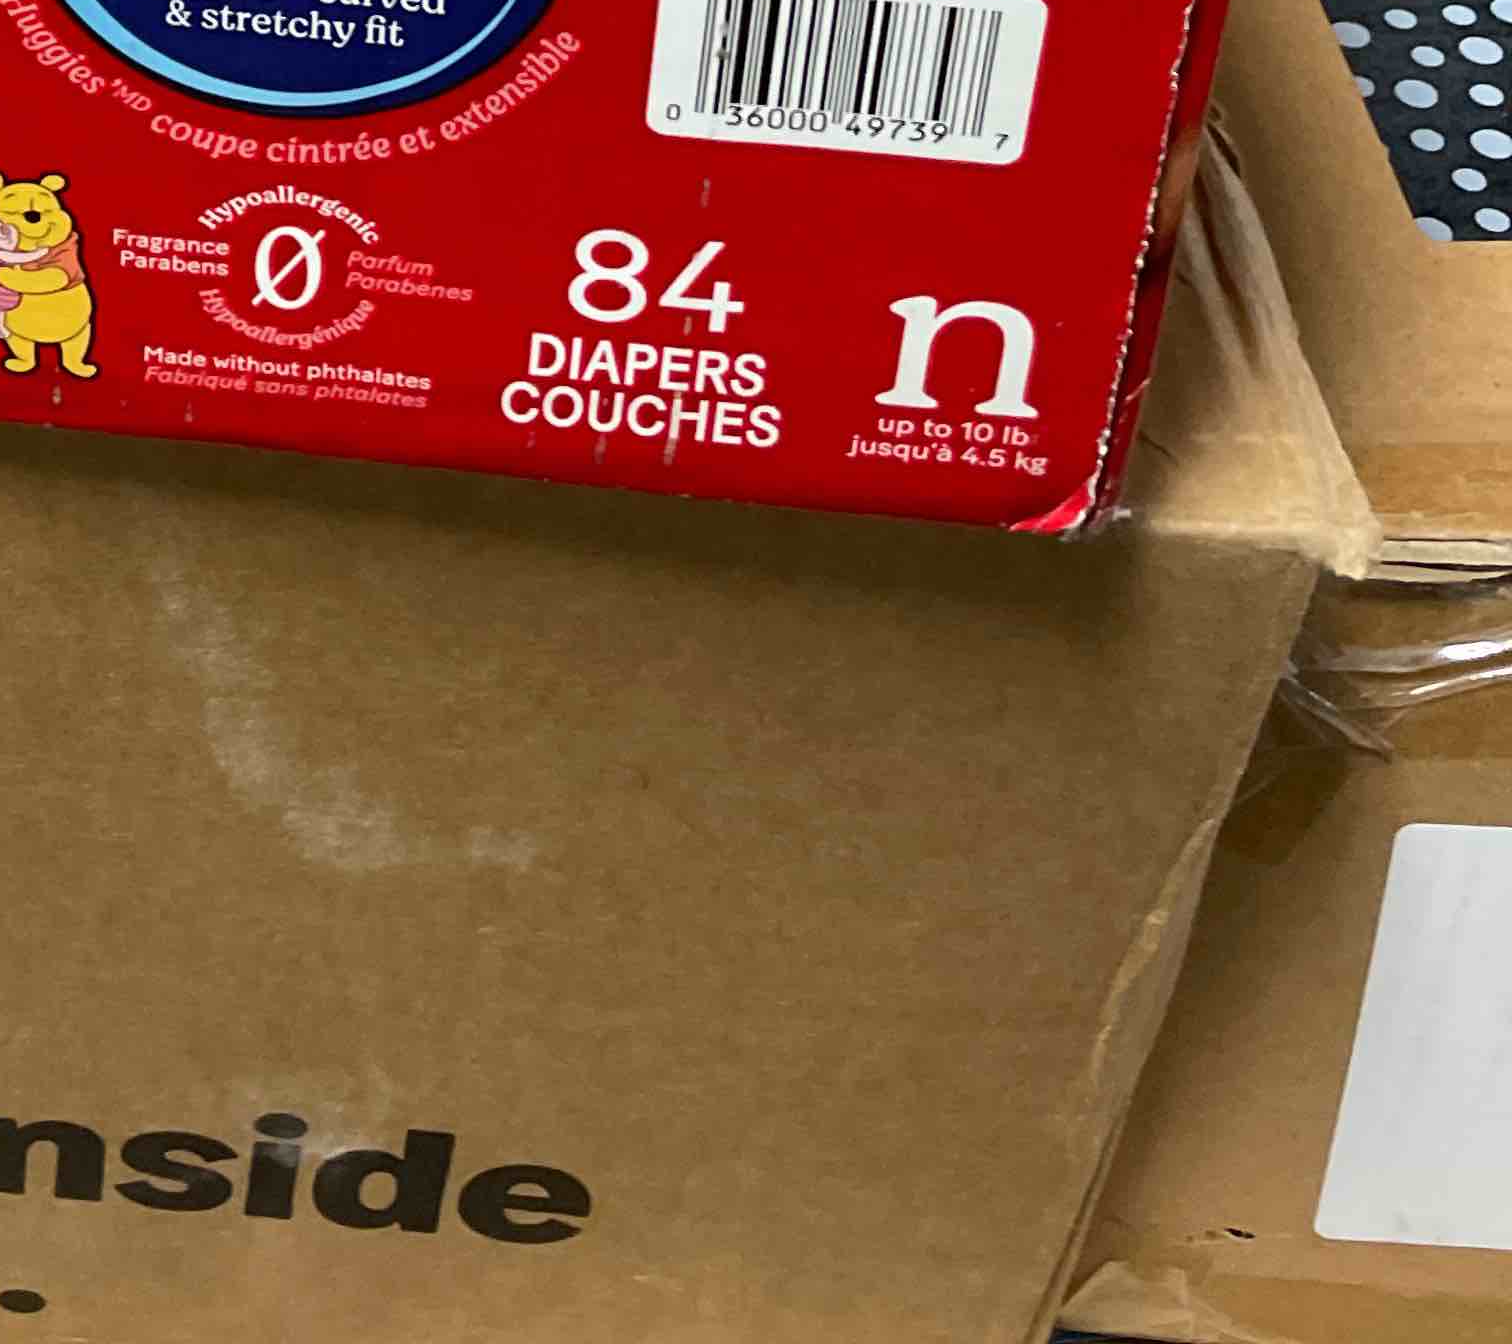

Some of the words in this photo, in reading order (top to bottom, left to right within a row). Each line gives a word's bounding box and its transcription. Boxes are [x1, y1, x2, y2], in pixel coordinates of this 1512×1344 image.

[199, 3, 356, 48] stretchy
[363, 14, 406, 47] fit
[149, 112, 260, 160] coupe
[265, 131, 391, 165] cintrée
[398, 125, 437, 155] et
[439, 30, 582, 143] extensible
[665, 103, 681, 121] 0
[724, 104, 829, 134] 36000
[845, 115, 950, 145] 49739
[993, 132, 1010, 152] 7
[197, 184, 380, 246] Hypoallergenic
[112, 227, 231, 257] Fragrance
[119, 249, 230, 278] Parabens
[345, 249, 435, 277] Parfum
[567, 227, 745, 334] 84
[198, 287, 376, 351] Hypoallergénique
[142, 345, 207, 369] Made
[213, 351, 300, 379] without
[306, 363, 433, 392] phthalates
[527, 331, 769, 400] DIAPERS
[873, 294, 1039, 419] n
[143, 365, 248, 393] Fabriqué
[254, 378, 309, 399] sans
[313, 382, 429, 410] phtalates
[500, 380, 783, 449] COUCHES
[877, 417, 916, 439] up
[922, 418, 953, 439] to
[960, 421, 995, 443] 10
[1001, 425, 1031, 447] lb
[845, 434, 953, 463] jusqu'à
[959, 446, 1007, 468] 4.5
[1014, 451, 1049, 476] kg
